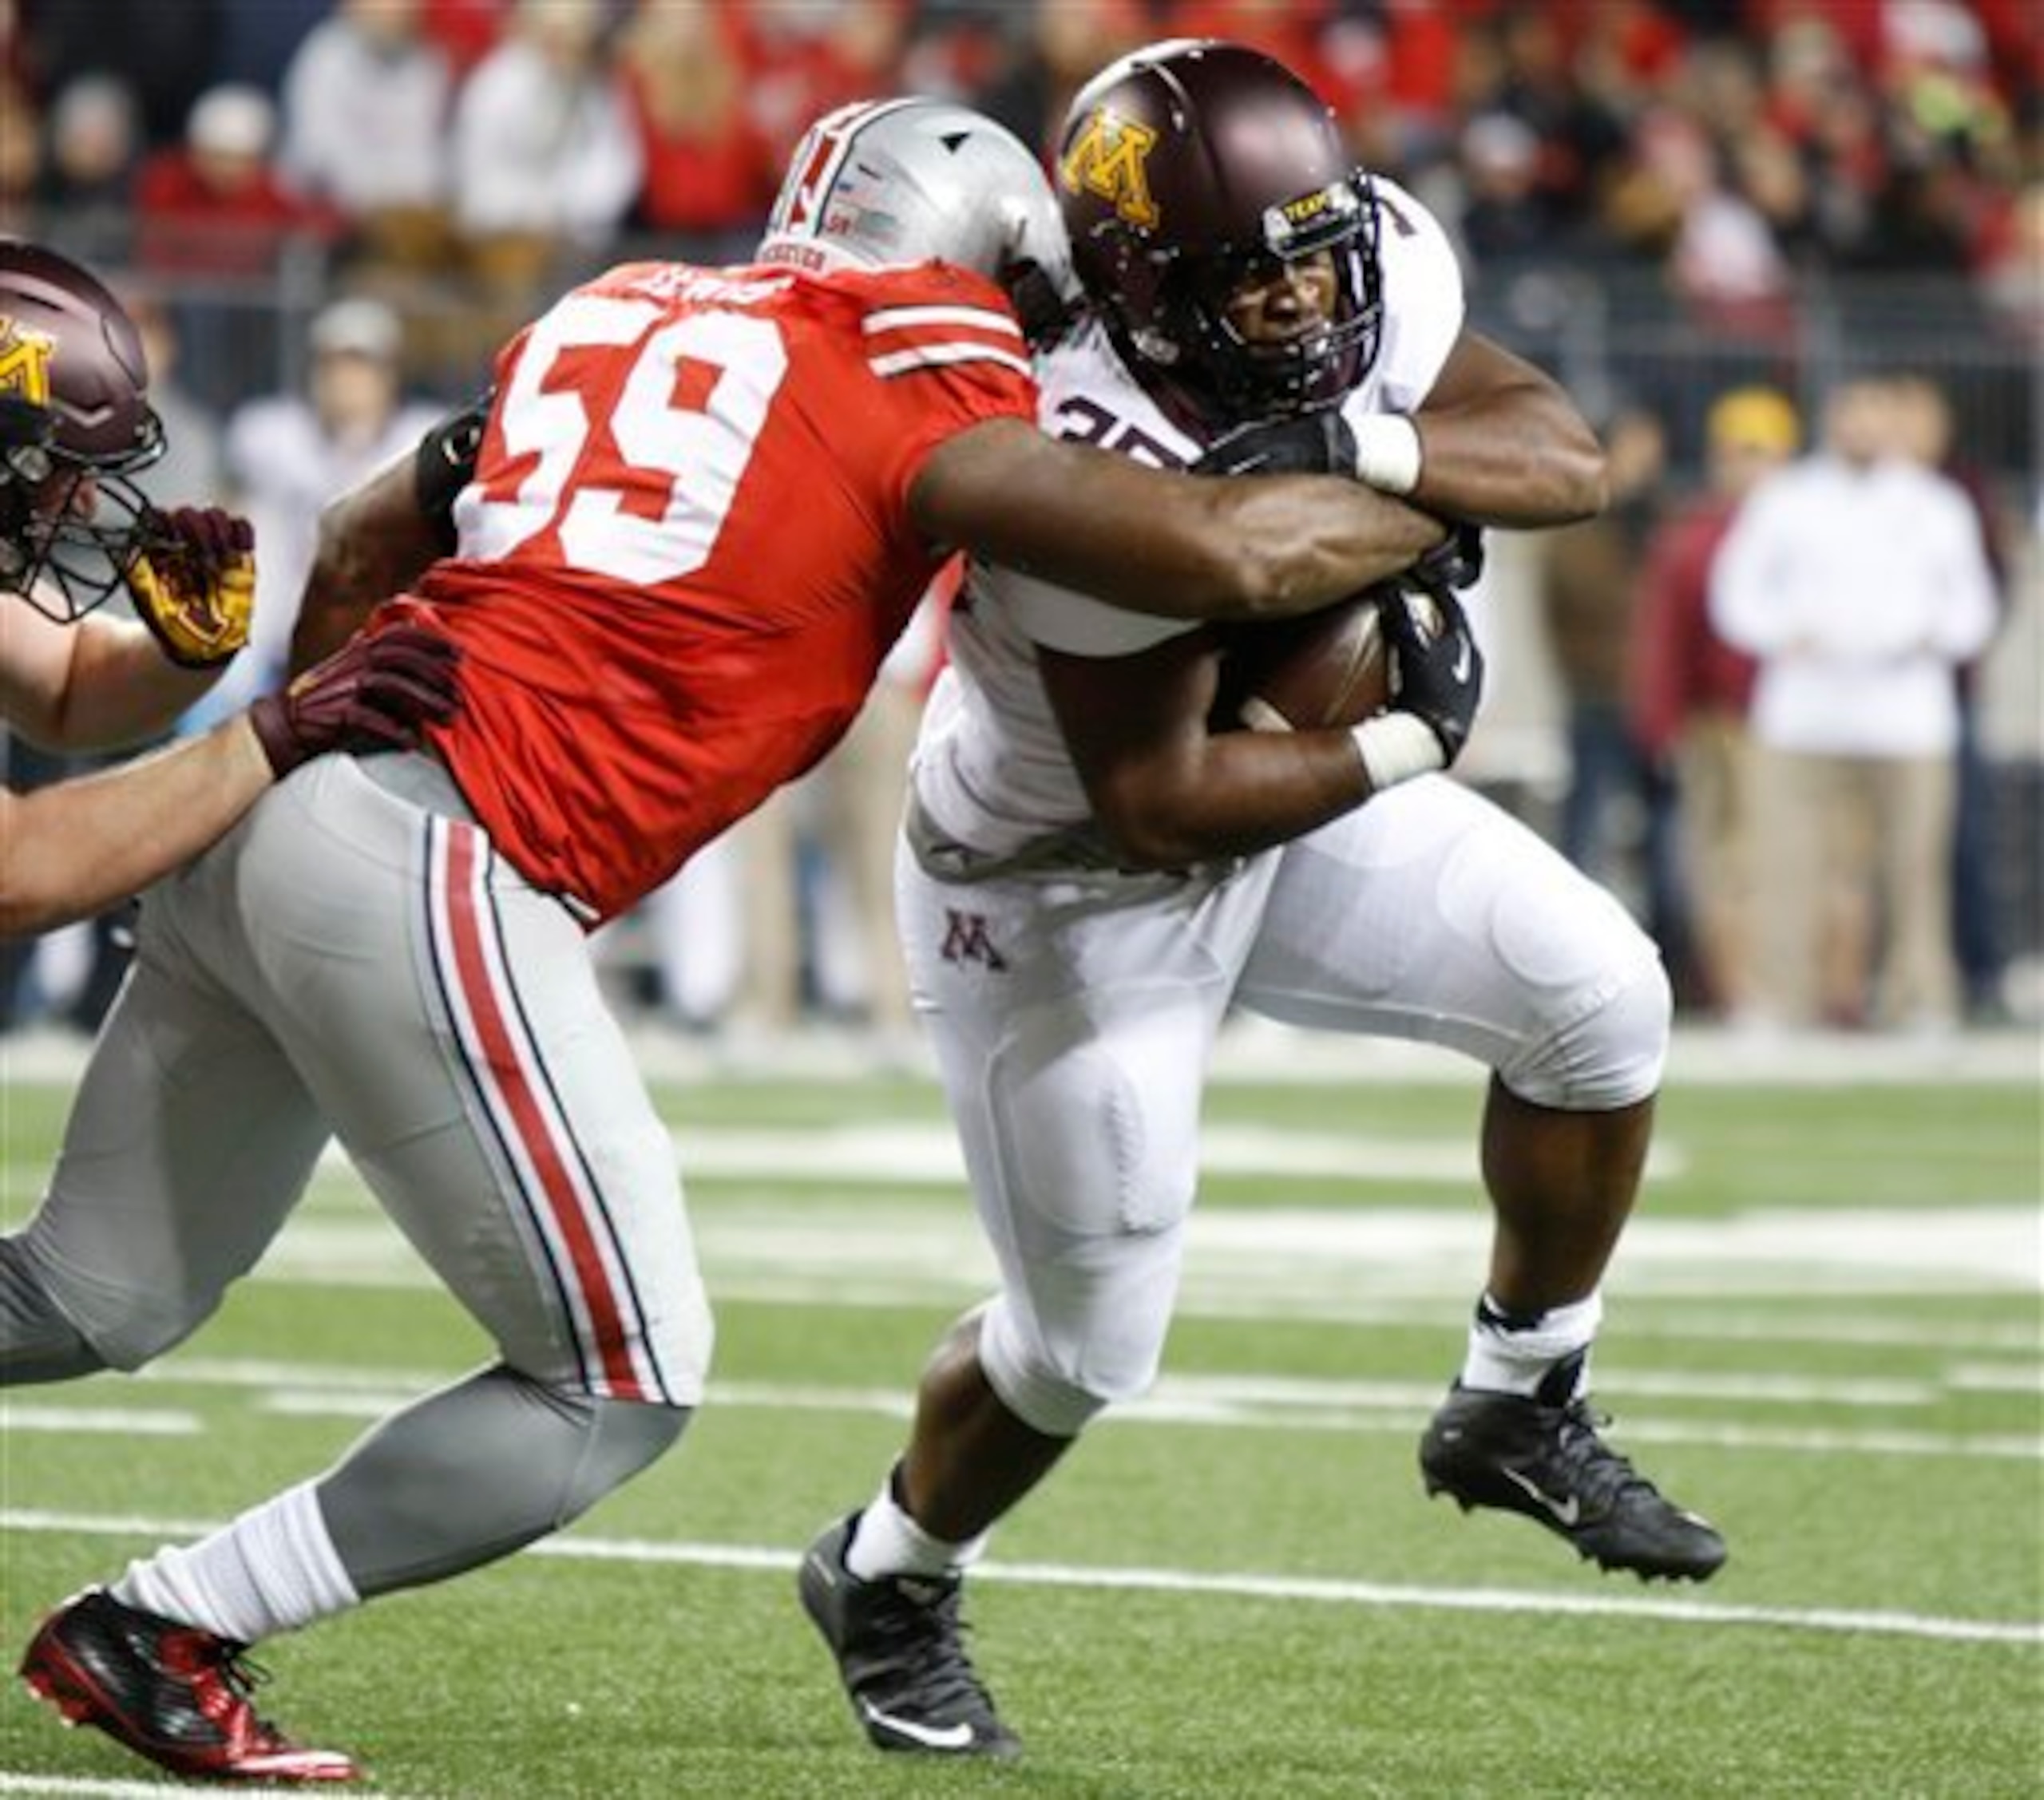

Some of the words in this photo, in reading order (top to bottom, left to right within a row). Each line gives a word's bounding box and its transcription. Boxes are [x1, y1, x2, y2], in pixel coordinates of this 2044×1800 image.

[1062, 107, 1159, 230] M
[453, 294, 789, 586] 59
[941, 908, 1007, 971] M
